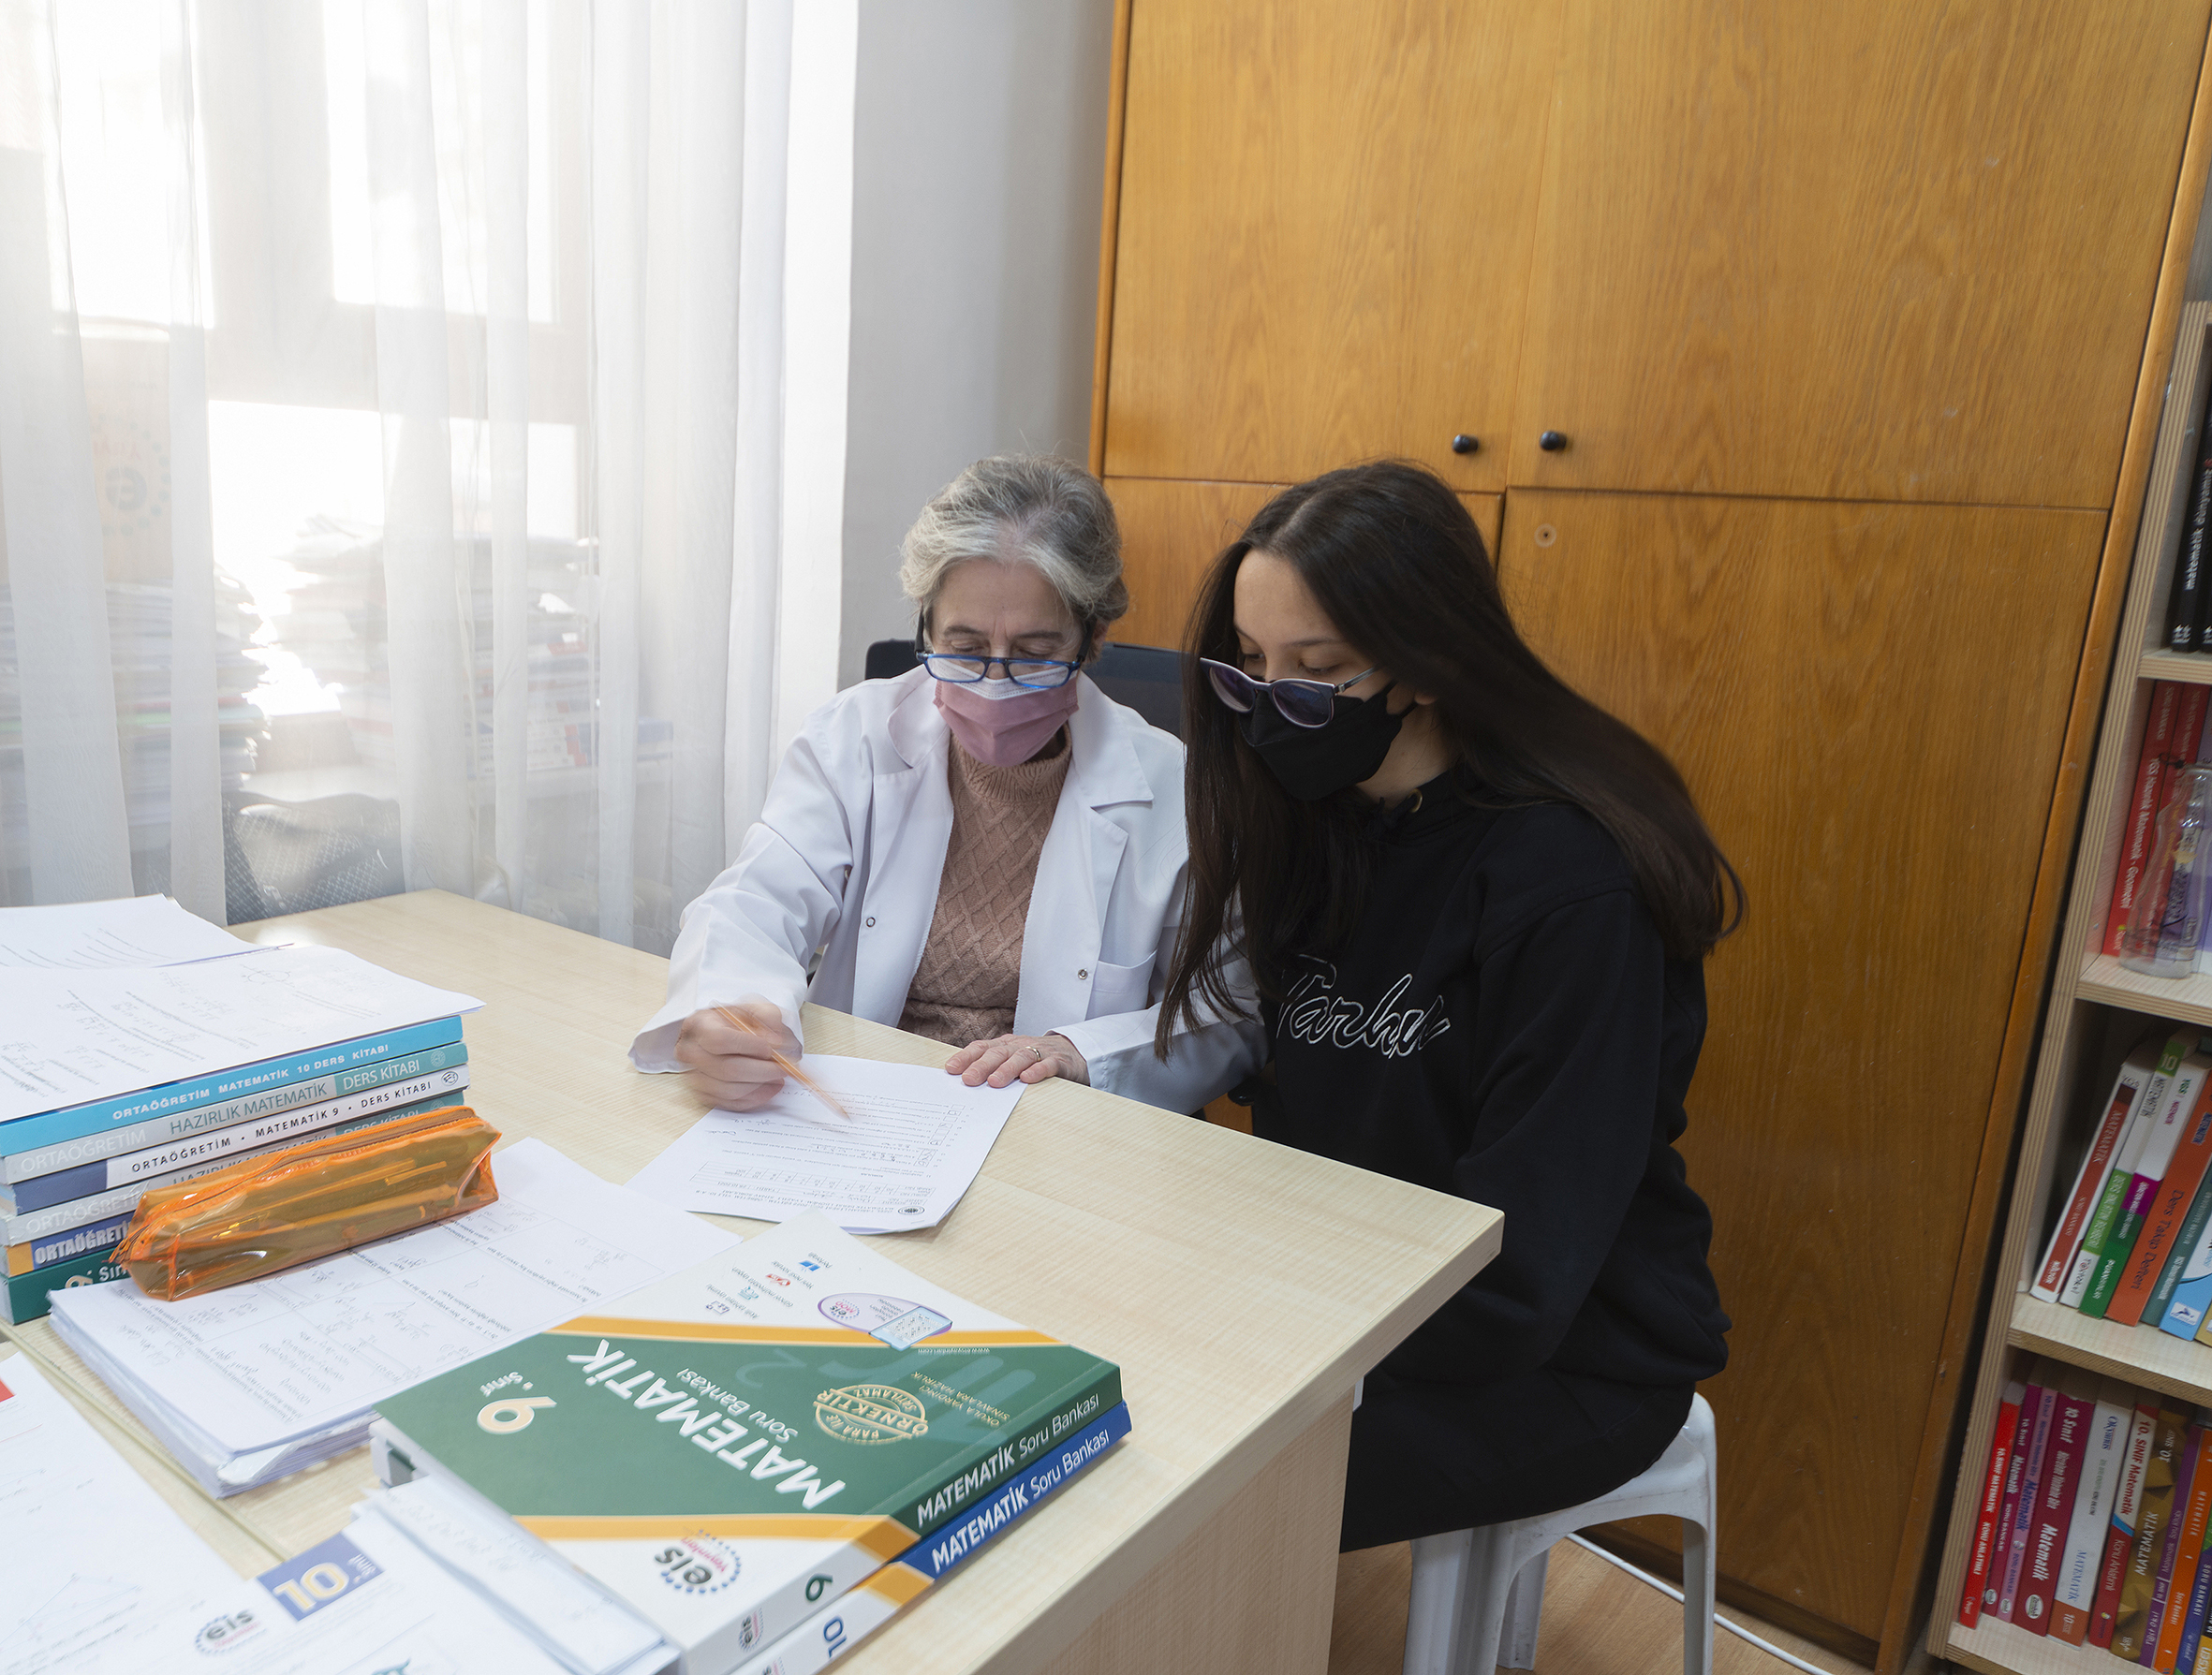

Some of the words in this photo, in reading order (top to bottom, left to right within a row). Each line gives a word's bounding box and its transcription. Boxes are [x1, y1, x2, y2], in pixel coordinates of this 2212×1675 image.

[112, 1088, 210, 1121] ORTAÖĞRETİM
[218, 1068, 289, 1095] MATEMATİK
[297, 1063, 310, 1074] 10
[314, 1054, 346, 1070] DERS
[352, 1044, 389, 1060] KİTABI
[21, 1128, 147, 1172] ORTAÖĞRETİM
[170, 1105, 241, 1136] HAZIRLIK
[243, 1082, 328, 1117] MATEMATİK
[342, 1071, 378, 1091] DERS
[379, 1059, 420, 1082] KİTABI
[131, 1137, 231, 1173] ORTAÖĞRETİM
[255, 1110, 328, 1139] MATEMATİK
[332, 1107, 339, 1117] 9
[361, 1092, 391, 1109] DERS
[394, 1080, 432, 1098] KİTABI
[2163, 1189, 2185, 1216] Ders
[34, 1219, 131, 1265] ORTAÖĞRETİ
[2148, 1219, 2173, 1250] Takip
[2131, 1251, 2157, 1290] Defteri
[479, 1371, 524, 1397] Sınıf
[676, 1368, 750, 1417] Bankası
[853, 1388, 918, 1412] SATILAMAZ
[911, 1371, 956, 1394] HAZIRLIK
[919, 1385, 964, 1411] YARDINCI
[566, 1338, 846, 1510] MATEMATİK
[816, 1389, 929, 1435] ÖRNEKTİR
[826, 1414, 844, 1429] İLE
[956, 1390, 1010, 1421] SINAVLARA
[966, 1405, 1000, 1427] OKULA
[748, 1409, 798, 1443] Soru
[843, 1424, 879, 1439] PARA
[2060, 1418, 2077, 1444] Sınıf
[2137, 1420, 2151, 1436] 10.
[917, 1443, 1015, 1528] MATEMATİK
[1019, 1427, 1049, 1458] Soru
[1052, 1392, 1099, 1436] Bankası
[2131, 1438, 2146, 1464] SINIF
[2006, 1454, 2025, 1493] Matematik
[2120, 1463, 2142, 1516] Matematik
[931, 1483, 1029, 1574] MATEMATİK
[1030, 1465, 1061, 1497] Soru
[1062, 1429, 1110, 1475] Bankası
[1985, 1475, 2000, 1513] MATEMATİK
[2015, 1479, 2038, 1532] Matematik
[2031, 1523, 2058, 1581] Matematik
[2113, 1539, 2126, 1559] Konu
[2134, 1510, 2160, 1577] MATEMATİK
[654, 1546, 713, 1584] eis
[2067, 1550, 2087, 1602] MATEMATİK
[2201, 1564, 2211, 1583] SORU
[2192, 1584, 2207, 1617] BANKASI
[206, 1609, 254, 1640] eis
[823, 1616, 848, 1658] 10
